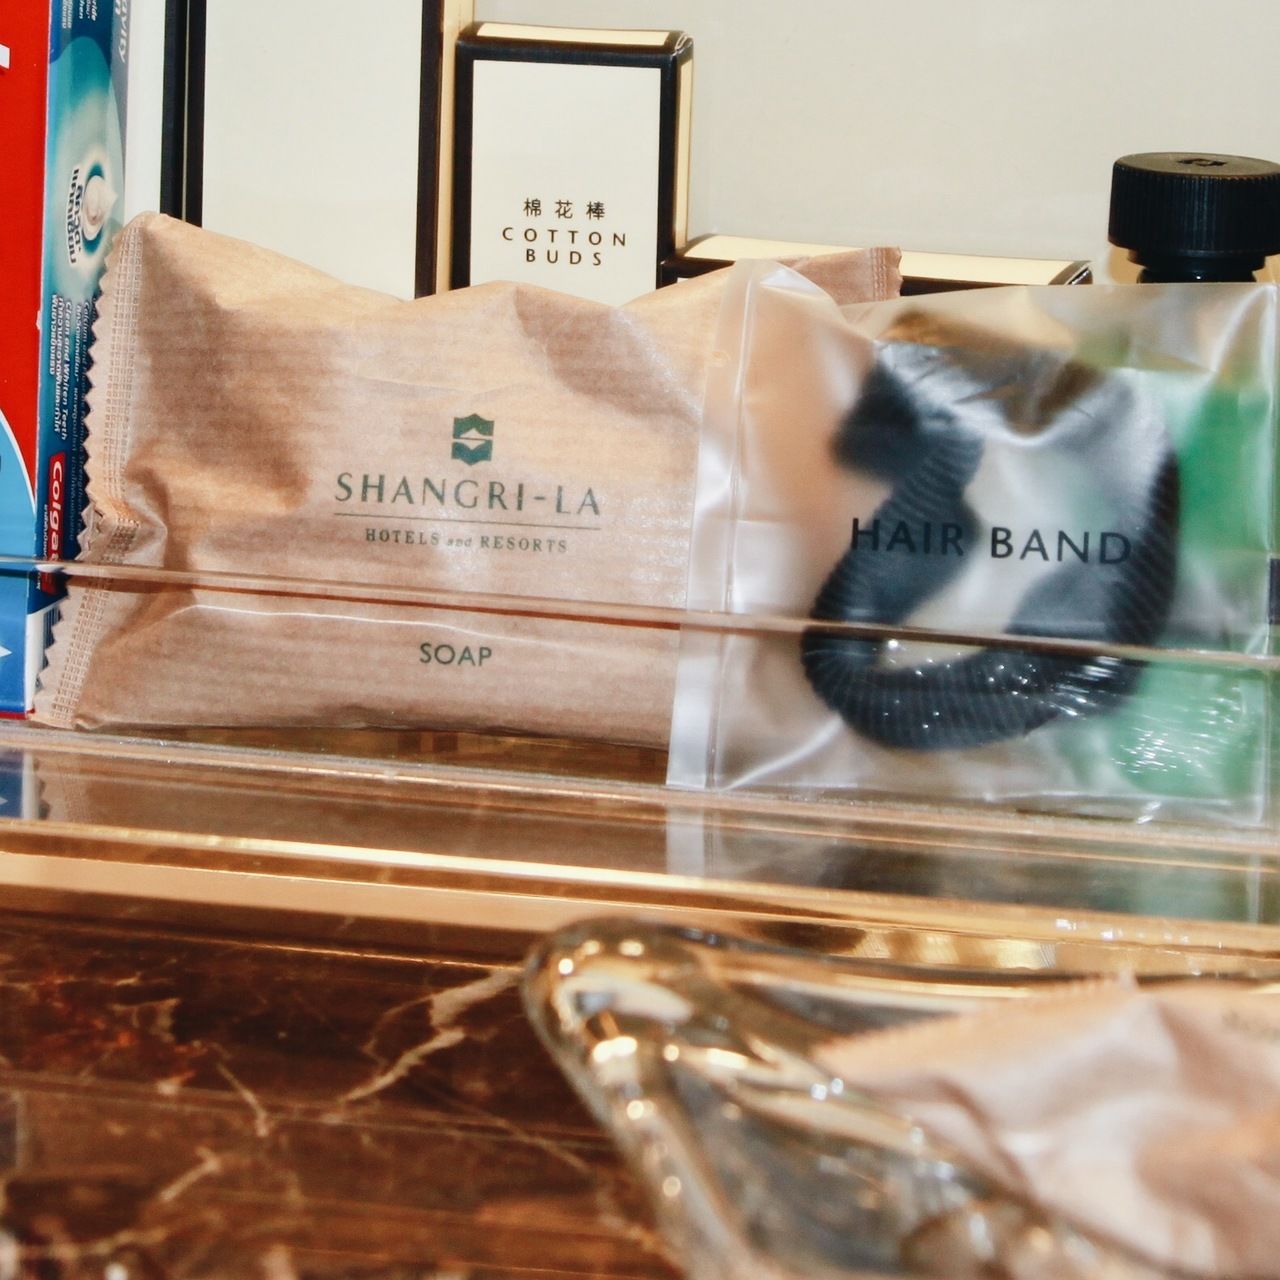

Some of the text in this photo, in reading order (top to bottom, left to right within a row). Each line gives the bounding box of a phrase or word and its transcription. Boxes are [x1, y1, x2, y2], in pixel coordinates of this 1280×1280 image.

[523, 197, 606, 221] 棉花棒
[502, 226, 627, 248] COTTON
[525, 248, 602, 267] BUDS
[334, 472, 602, 516] SHANGRI-LA
[364, 527, 568, 553] HOTELS and RESORTS
[851, 517, 1132, 566] HAIR BAND
[419, 642, 493, 667] SOAP
